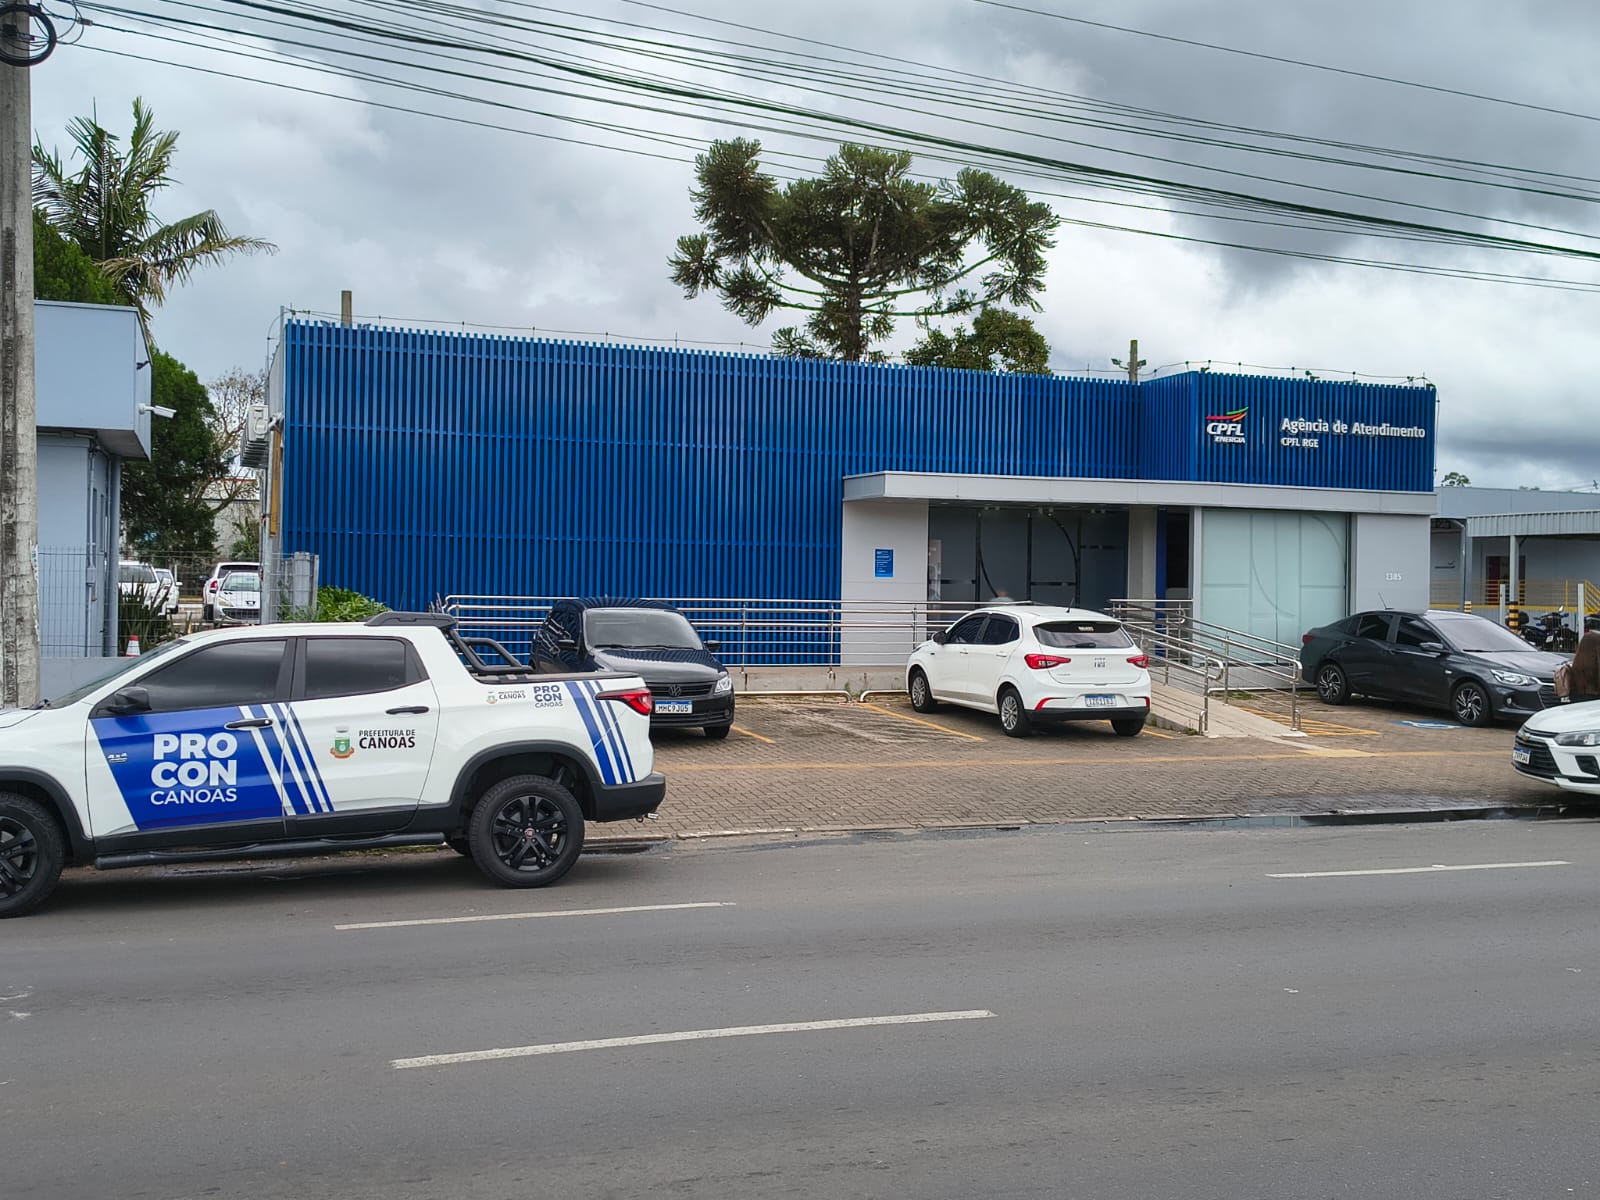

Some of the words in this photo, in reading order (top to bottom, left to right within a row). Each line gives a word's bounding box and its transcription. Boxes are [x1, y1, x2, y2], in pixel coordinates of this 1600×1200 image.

[1206, 422, 1245, 436] CPFL
[1281, 418, 1329, 434] Agência
[1332, 420, 1348, 433] de
[1352, 422, 1426, 438] Atendimento
[1214, 436, 1246, 444] ENERGIA
[1281, 437, 1300, 446] CPFL
[1302, 438, 1319, 448] RGE
[533, 685, 560, 693] PRO
[534, 693, 562, 702] CON
[153, 732, 238, 760] PRO
[359, 736, 416, 749] CANOAS
[151, 760, 237, 788] CON
[150, 788, 238, 805] CANOAS
